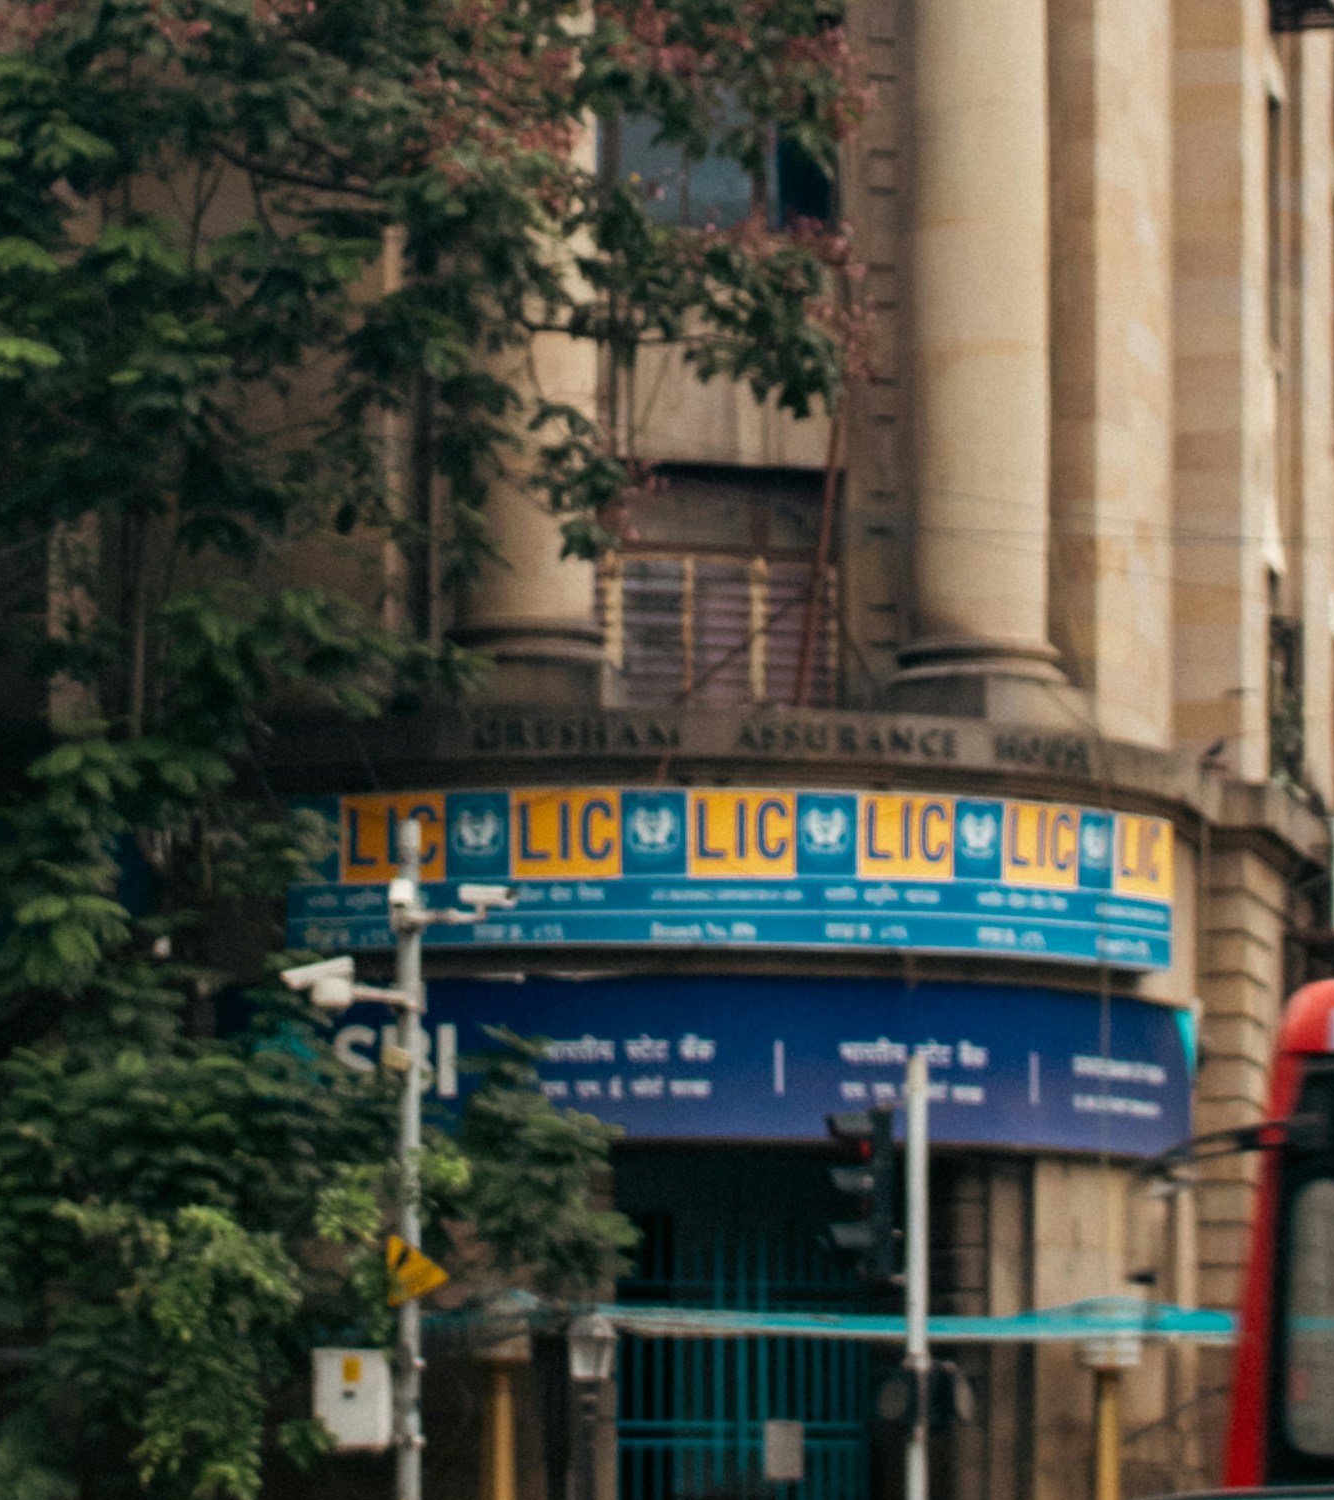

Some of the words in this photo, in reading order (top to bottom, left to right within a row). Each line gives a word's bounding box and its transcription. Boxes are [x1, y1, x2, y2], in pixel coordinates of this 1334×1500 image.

[519, 798, 614, 862] LIC
[697, 798, 789, 861] LIC
[866, 802, 947, 863] LIC
[1010, 808, 1075, 872] LIC
